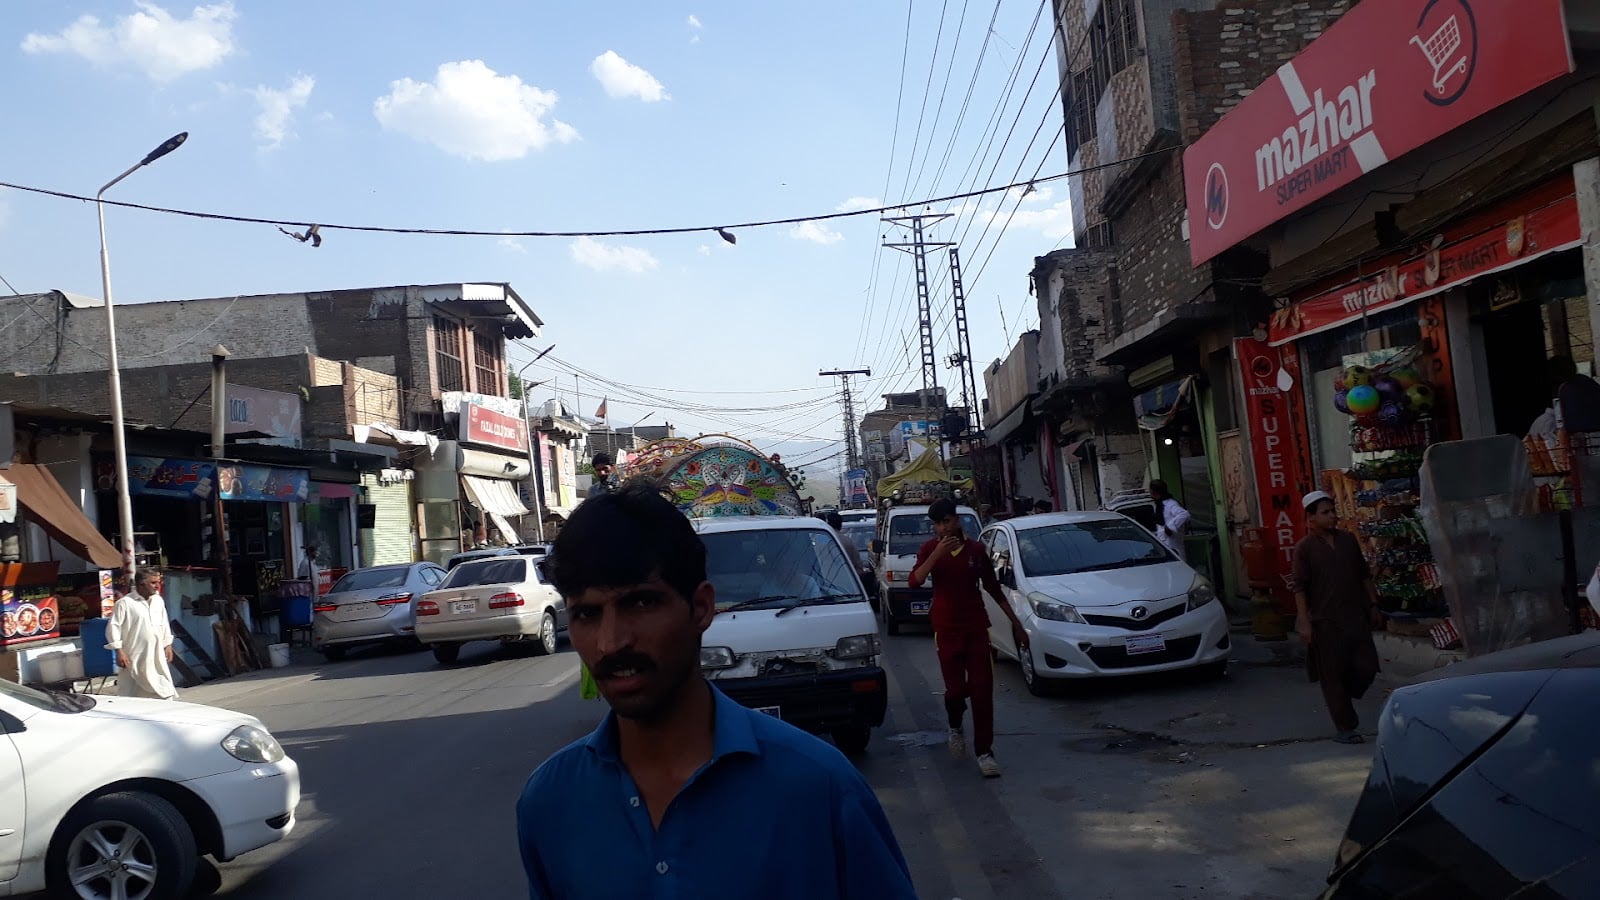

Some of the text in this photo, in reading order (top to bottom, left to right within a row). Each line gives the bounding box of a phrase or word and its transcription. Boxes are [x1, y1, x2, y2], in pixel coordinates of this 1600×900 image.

[1255, 69, 1376, 192] mazhar
[1277, 146, 1349, 205] SUPER MART
[1342, 272, 1408, 313] mazhr
[1261, 399, 1287, 488] SUPER
[1271, 494, 1297, 562] MART
